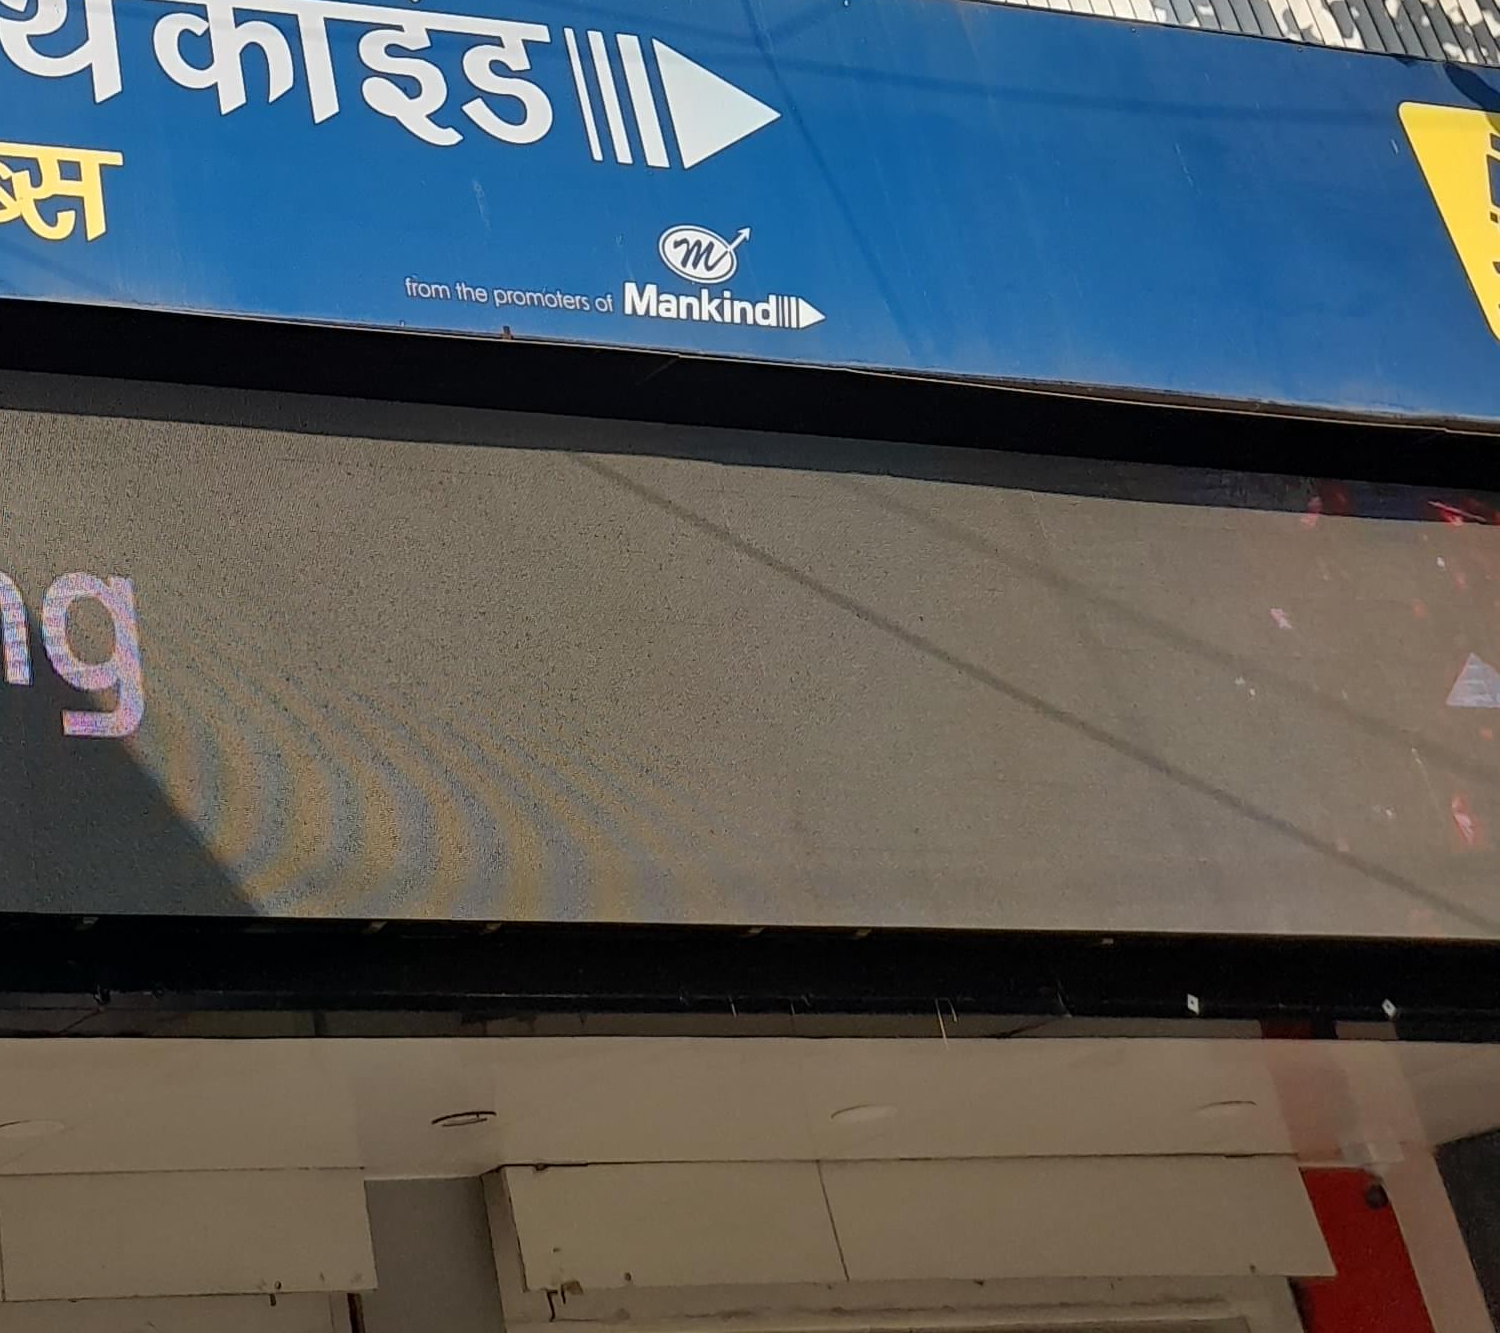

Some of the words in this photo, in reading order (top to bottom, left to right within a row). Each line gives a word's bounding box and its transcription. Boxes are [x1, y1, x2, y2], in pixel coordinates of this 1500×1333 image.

[404, 276, 449, 301] from
[454, 281, 488, 304] the
[493, 287, 590, 312] promoters
[594, 293, 614, 313] of
[623, 281, 777, 327] Mankind
